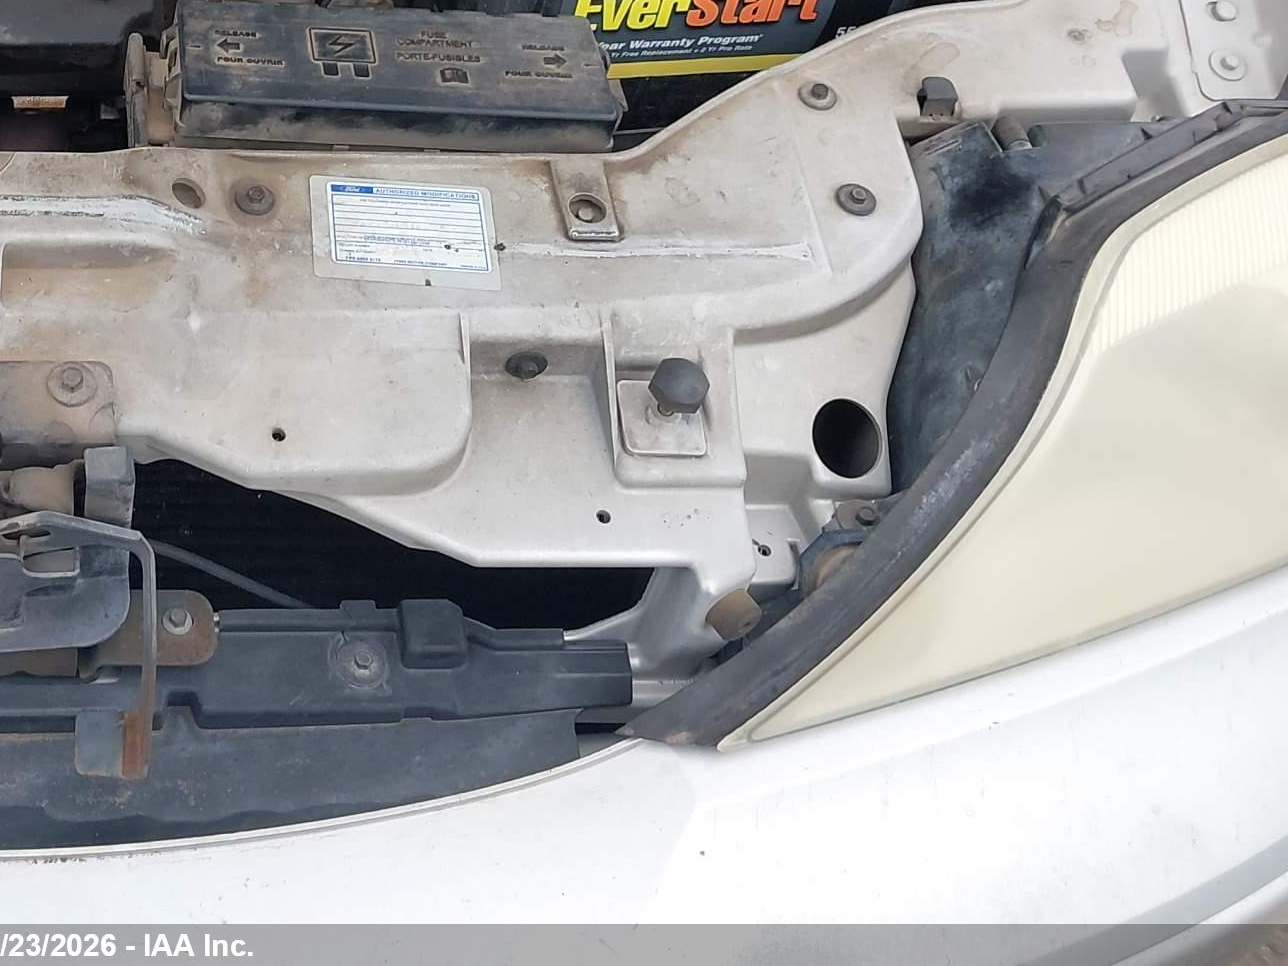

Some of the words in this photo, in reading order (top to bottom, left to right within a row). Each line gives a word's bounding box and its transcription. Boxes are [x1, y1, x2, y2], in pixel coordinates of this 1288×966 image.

[396, 38, 472, 48] COMPARTMENT
[599, 41, 626, 51] ear
[629, 38, 696, 49] Warranty
[621, 50, 639, 58] Free
[641, 48, 692, 56] Replacement
[216, 56, 244, 64] POUR
[376, 188, 419, 196] AUTHORIZED
[421, 190, 477, 200] MODIFICATIONS
